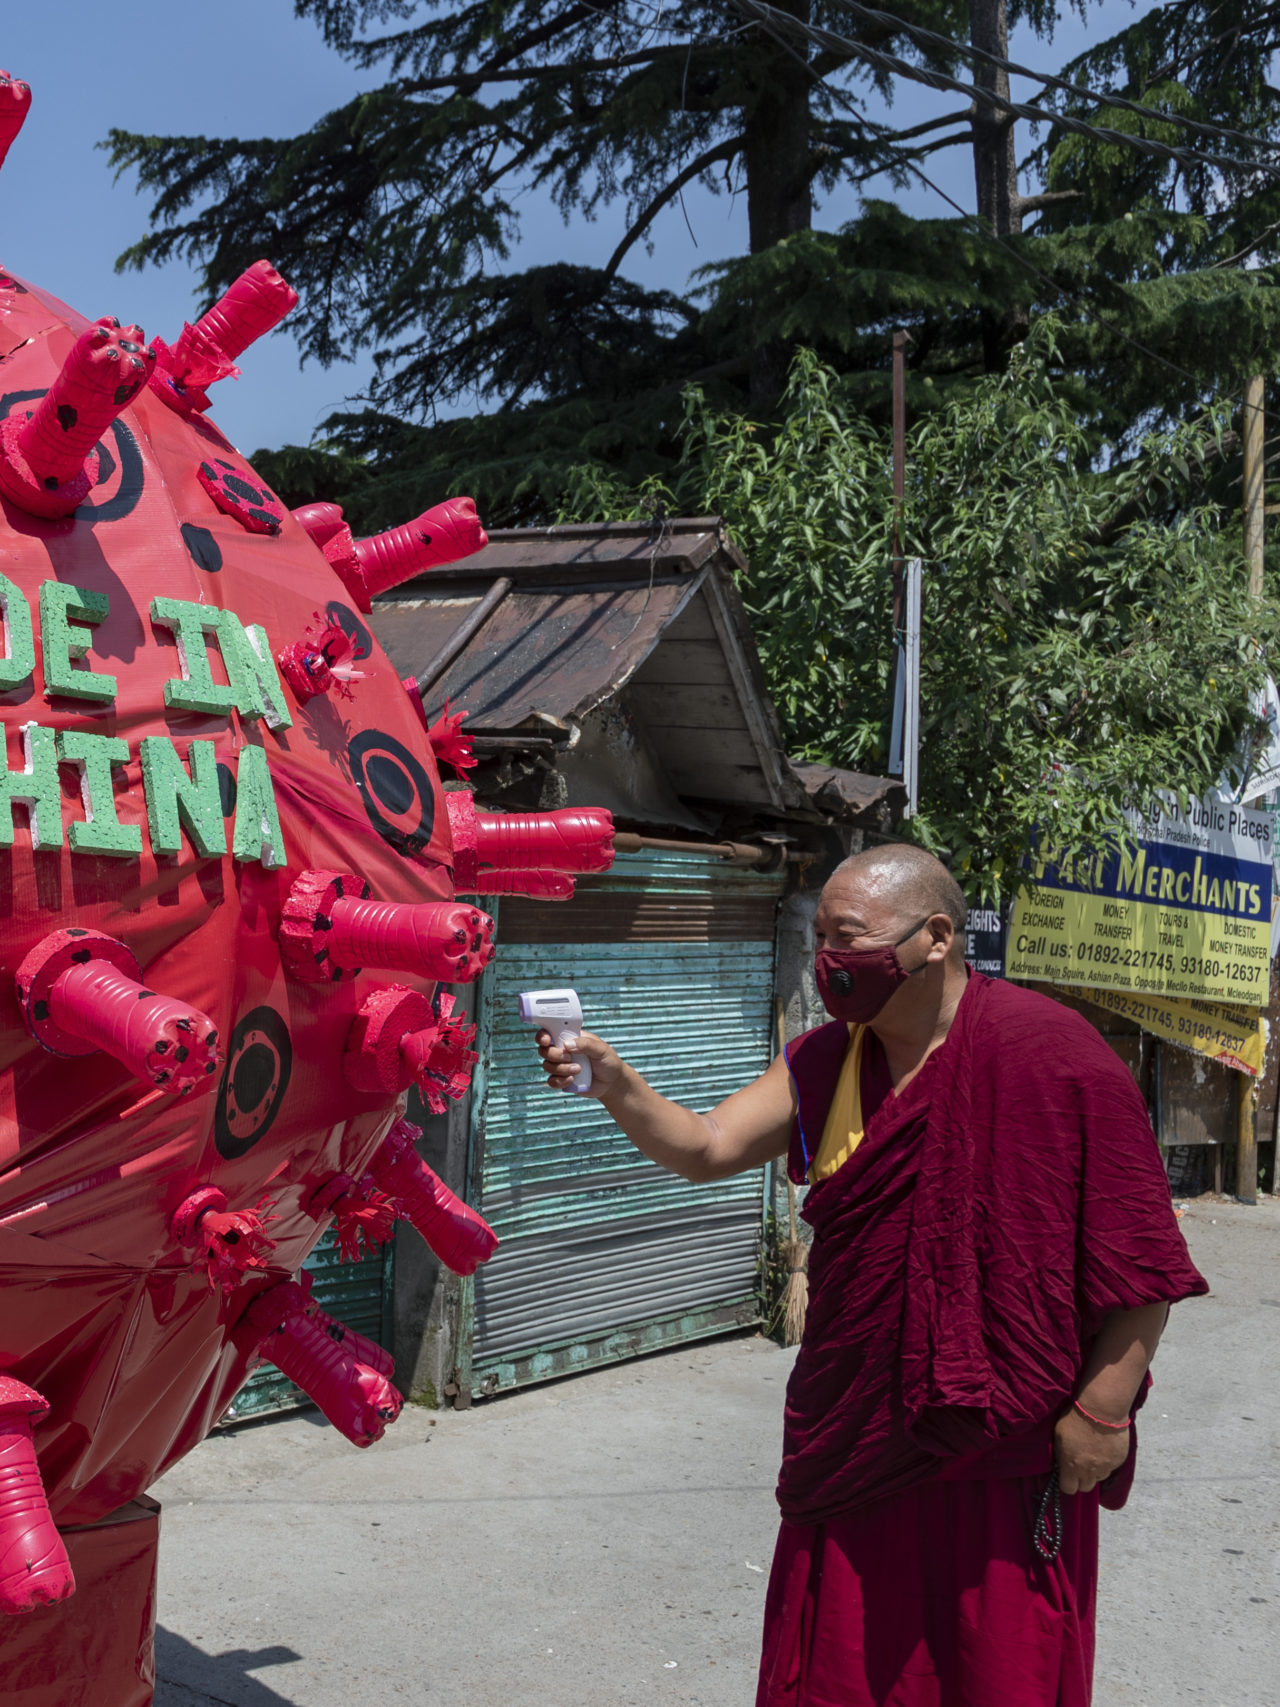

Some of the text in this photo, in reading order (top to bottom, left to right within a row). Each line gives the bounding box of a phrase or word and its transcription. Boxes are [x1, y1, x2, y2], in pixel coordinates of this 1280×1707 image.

[150, 596, 293, 732] IN
[1229, 811, 1270, 841] Places
[1166, 828, 1191, 844] Pradesh
[1029, 891, 1065, 910] FOREIGN
[965, 909, 1001, 932] EIGHTS
[1102, 903, 1129, 920] MONEY
[1159, 912, 1188, 929] TOURS &
[1022, 912, 1066, 931] EXCHANGE
[1223, 922, 1257, 940] DOMESTIC
[1094, 922, 1132, 941] TRANSFER
[1158, 932, 1185, 948] TRAVEL
[1016, 934, 1261, 983] Call us: 01892-221745, 93180-12637
[1209, 939, 1268, 960] MONEY TRANSFER
[1010, 961, 1042, 976] Address:
[1044, 964, 1061, 977] Main
[1088, 970, 1112, 983] Ashian
[1112, 972, 1132, 987] Plaza,
[1134, 975, 1164, 991] Opposite
[1188, 982, 1225, 998] Restaurant,
